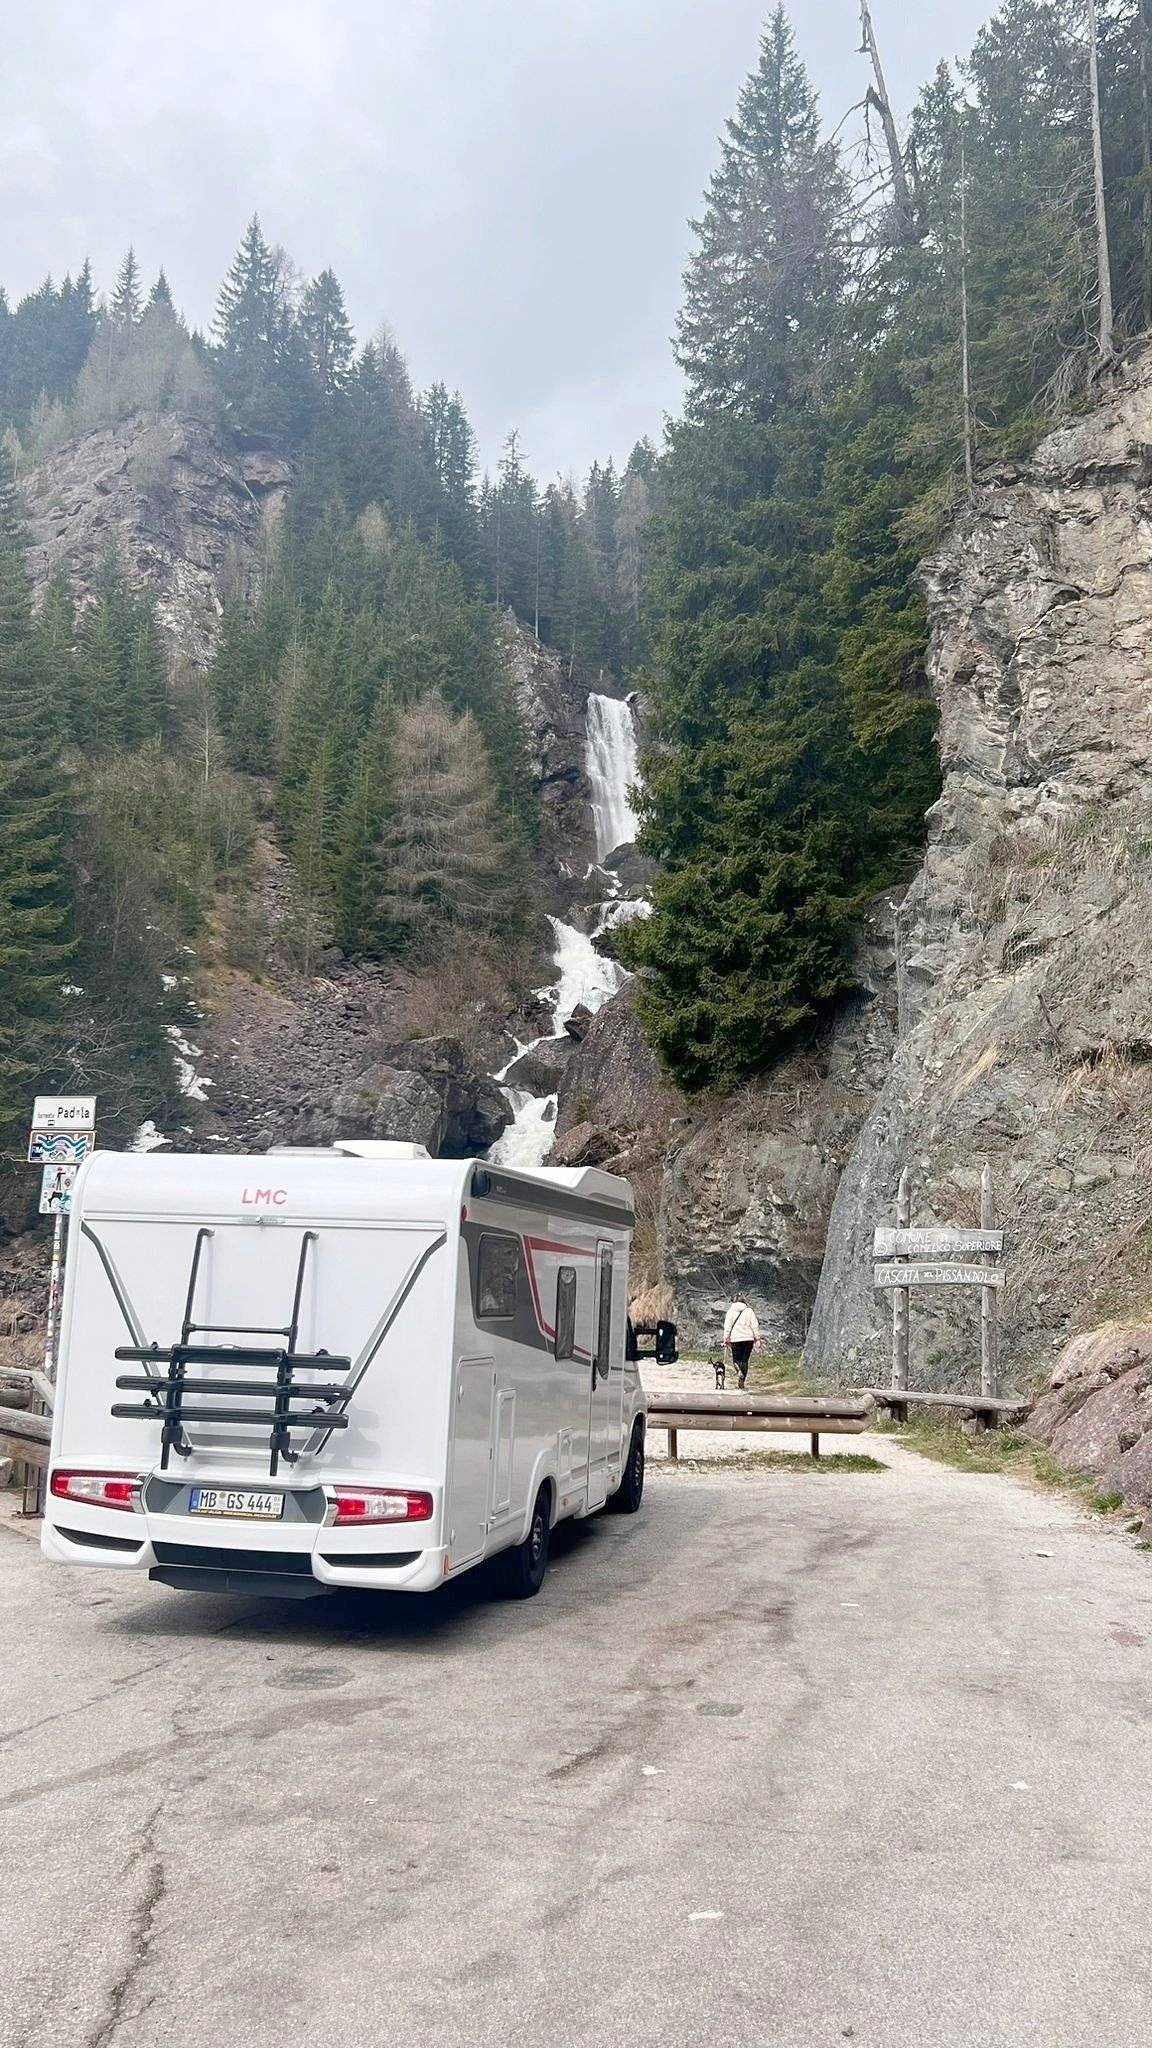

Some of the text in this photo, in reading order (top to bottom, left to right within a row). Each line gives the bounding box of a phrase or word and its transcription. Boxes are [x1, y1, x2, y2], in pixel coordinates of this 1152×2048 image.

[241, 1188, 288, 1205] LMC
[890, 1230, 932, 1244] COMUNE
[952, 1239, 1003, 1252] SUPERIORE
[878, 1268, 920, 1285] CASCATA
[935, 1267, 999, 1284] PISSANDOLO
[199, 1491, 217, 1508] MB
[226, 1493, 244, 1510] GS
[247, 1494, 272, 1512] 444
